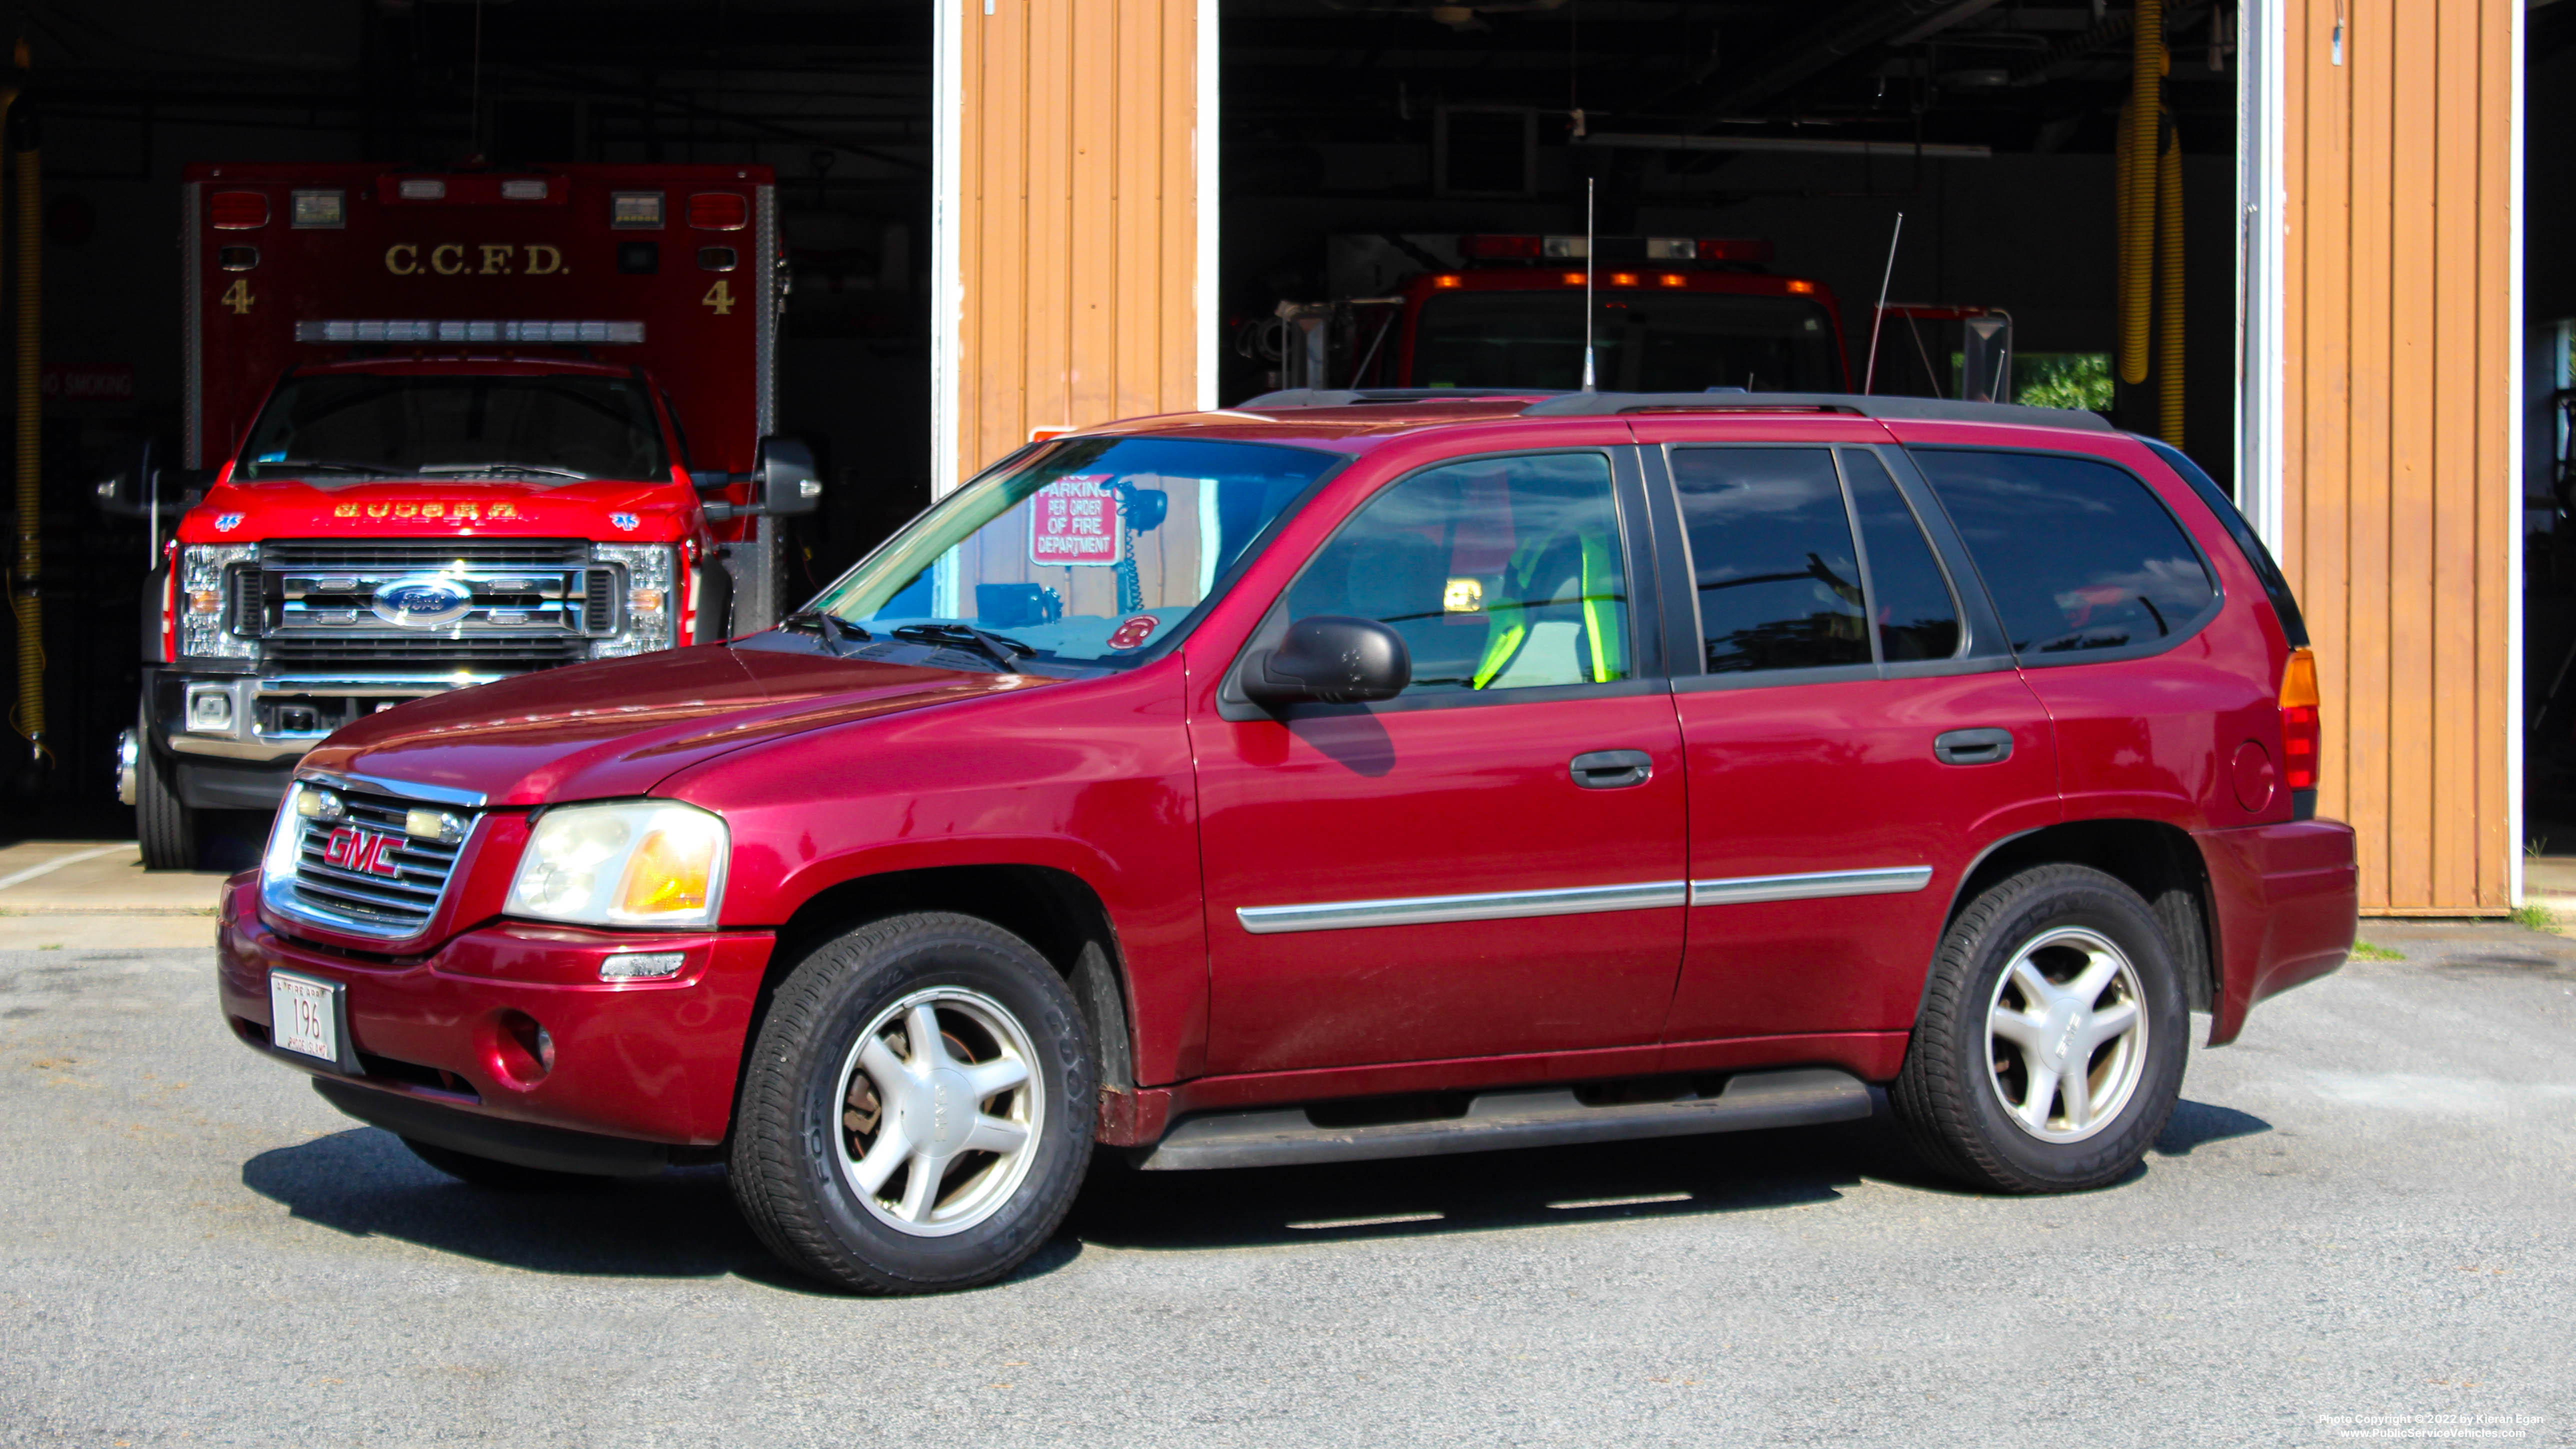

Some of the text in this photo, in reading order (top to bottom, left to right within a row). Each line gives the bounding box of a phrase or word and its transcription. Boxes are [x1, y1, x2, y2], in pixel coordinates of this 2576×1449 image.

[222, 279, 254, 314] 4
[702, 278, 736, 315] 4
[64, 373, 132, 396] SMOKING
[1038, 482, 1112, 498] PARKING
[1048, 499, 1102, 516] PER ORDER
[1047, 517, 1103, 534] OF FIRE
[1038, 536, 1110, 554] DEPARTMENT
[398, 592, 445, 610] Ford
[324, 826, 410, 878] GMC
[294, 998, 320, 1039] 196
